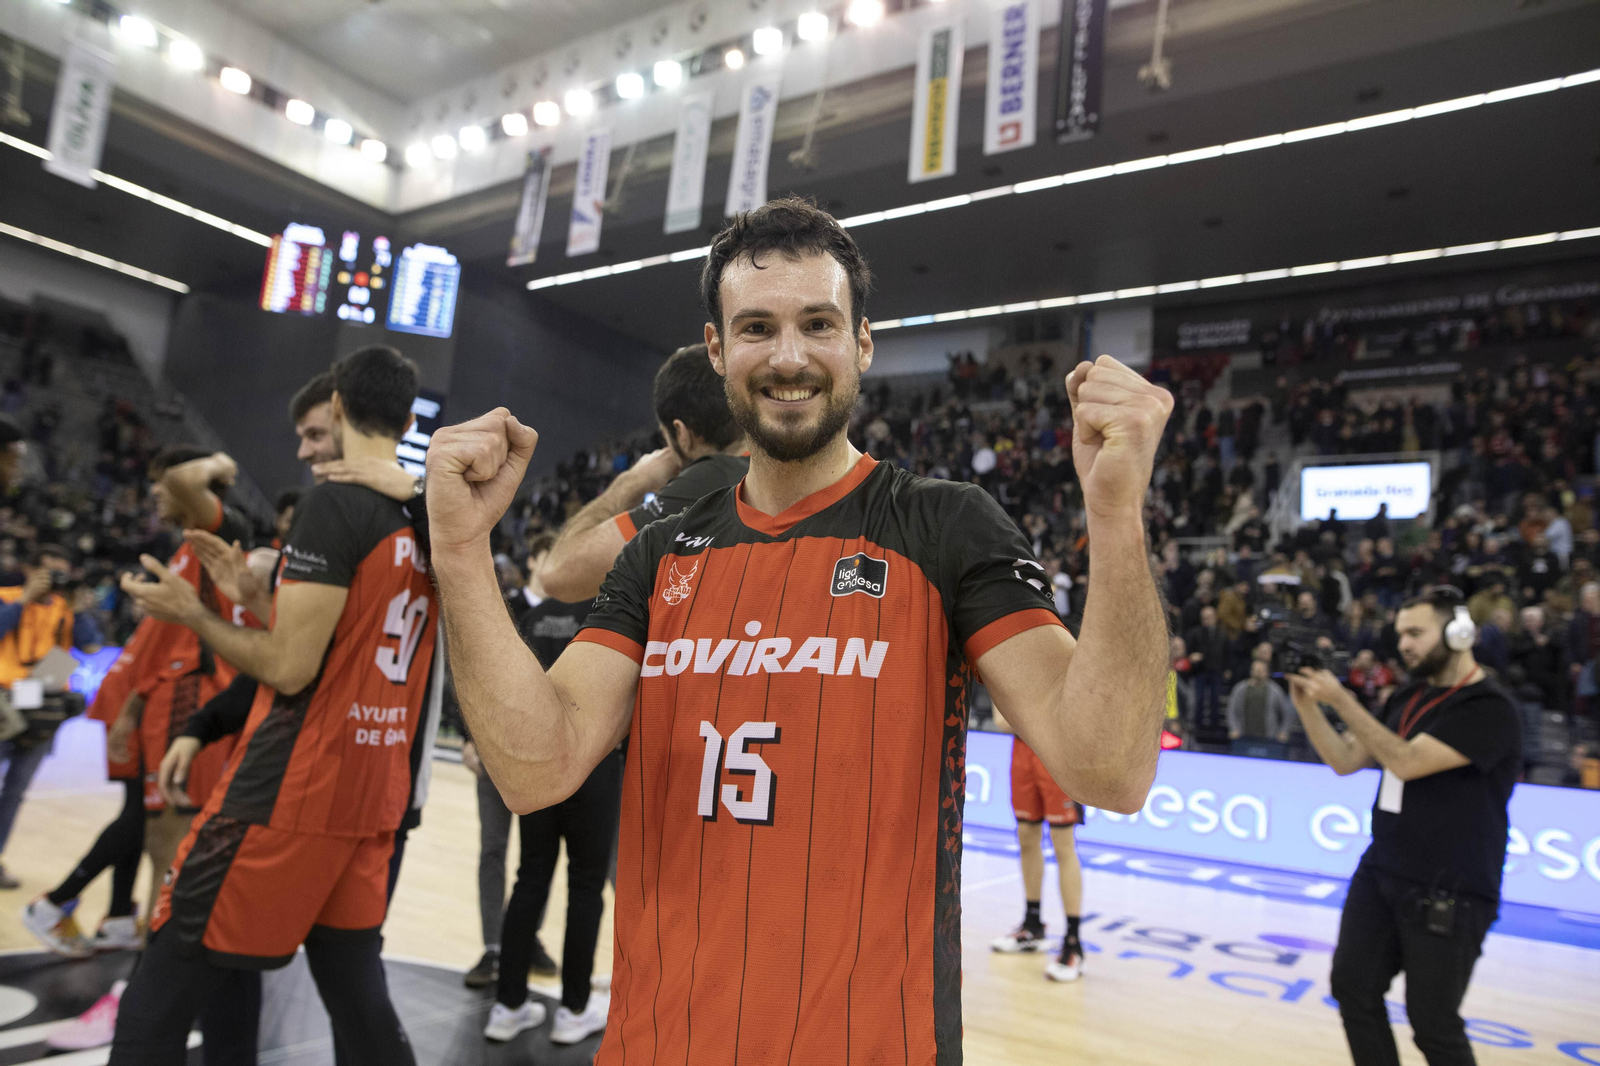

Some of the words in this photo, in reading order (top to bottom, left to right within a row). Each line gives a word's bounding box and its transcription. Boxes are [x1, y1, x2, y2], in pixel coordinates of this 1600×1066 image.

[999, 2, 1027, 115] BERNER
[837, 575, 881, 592] endesa
[839, 568, 857, 581] liga
[355, 728, 381, 746] DE
[697, 720, 782, 827] 15
